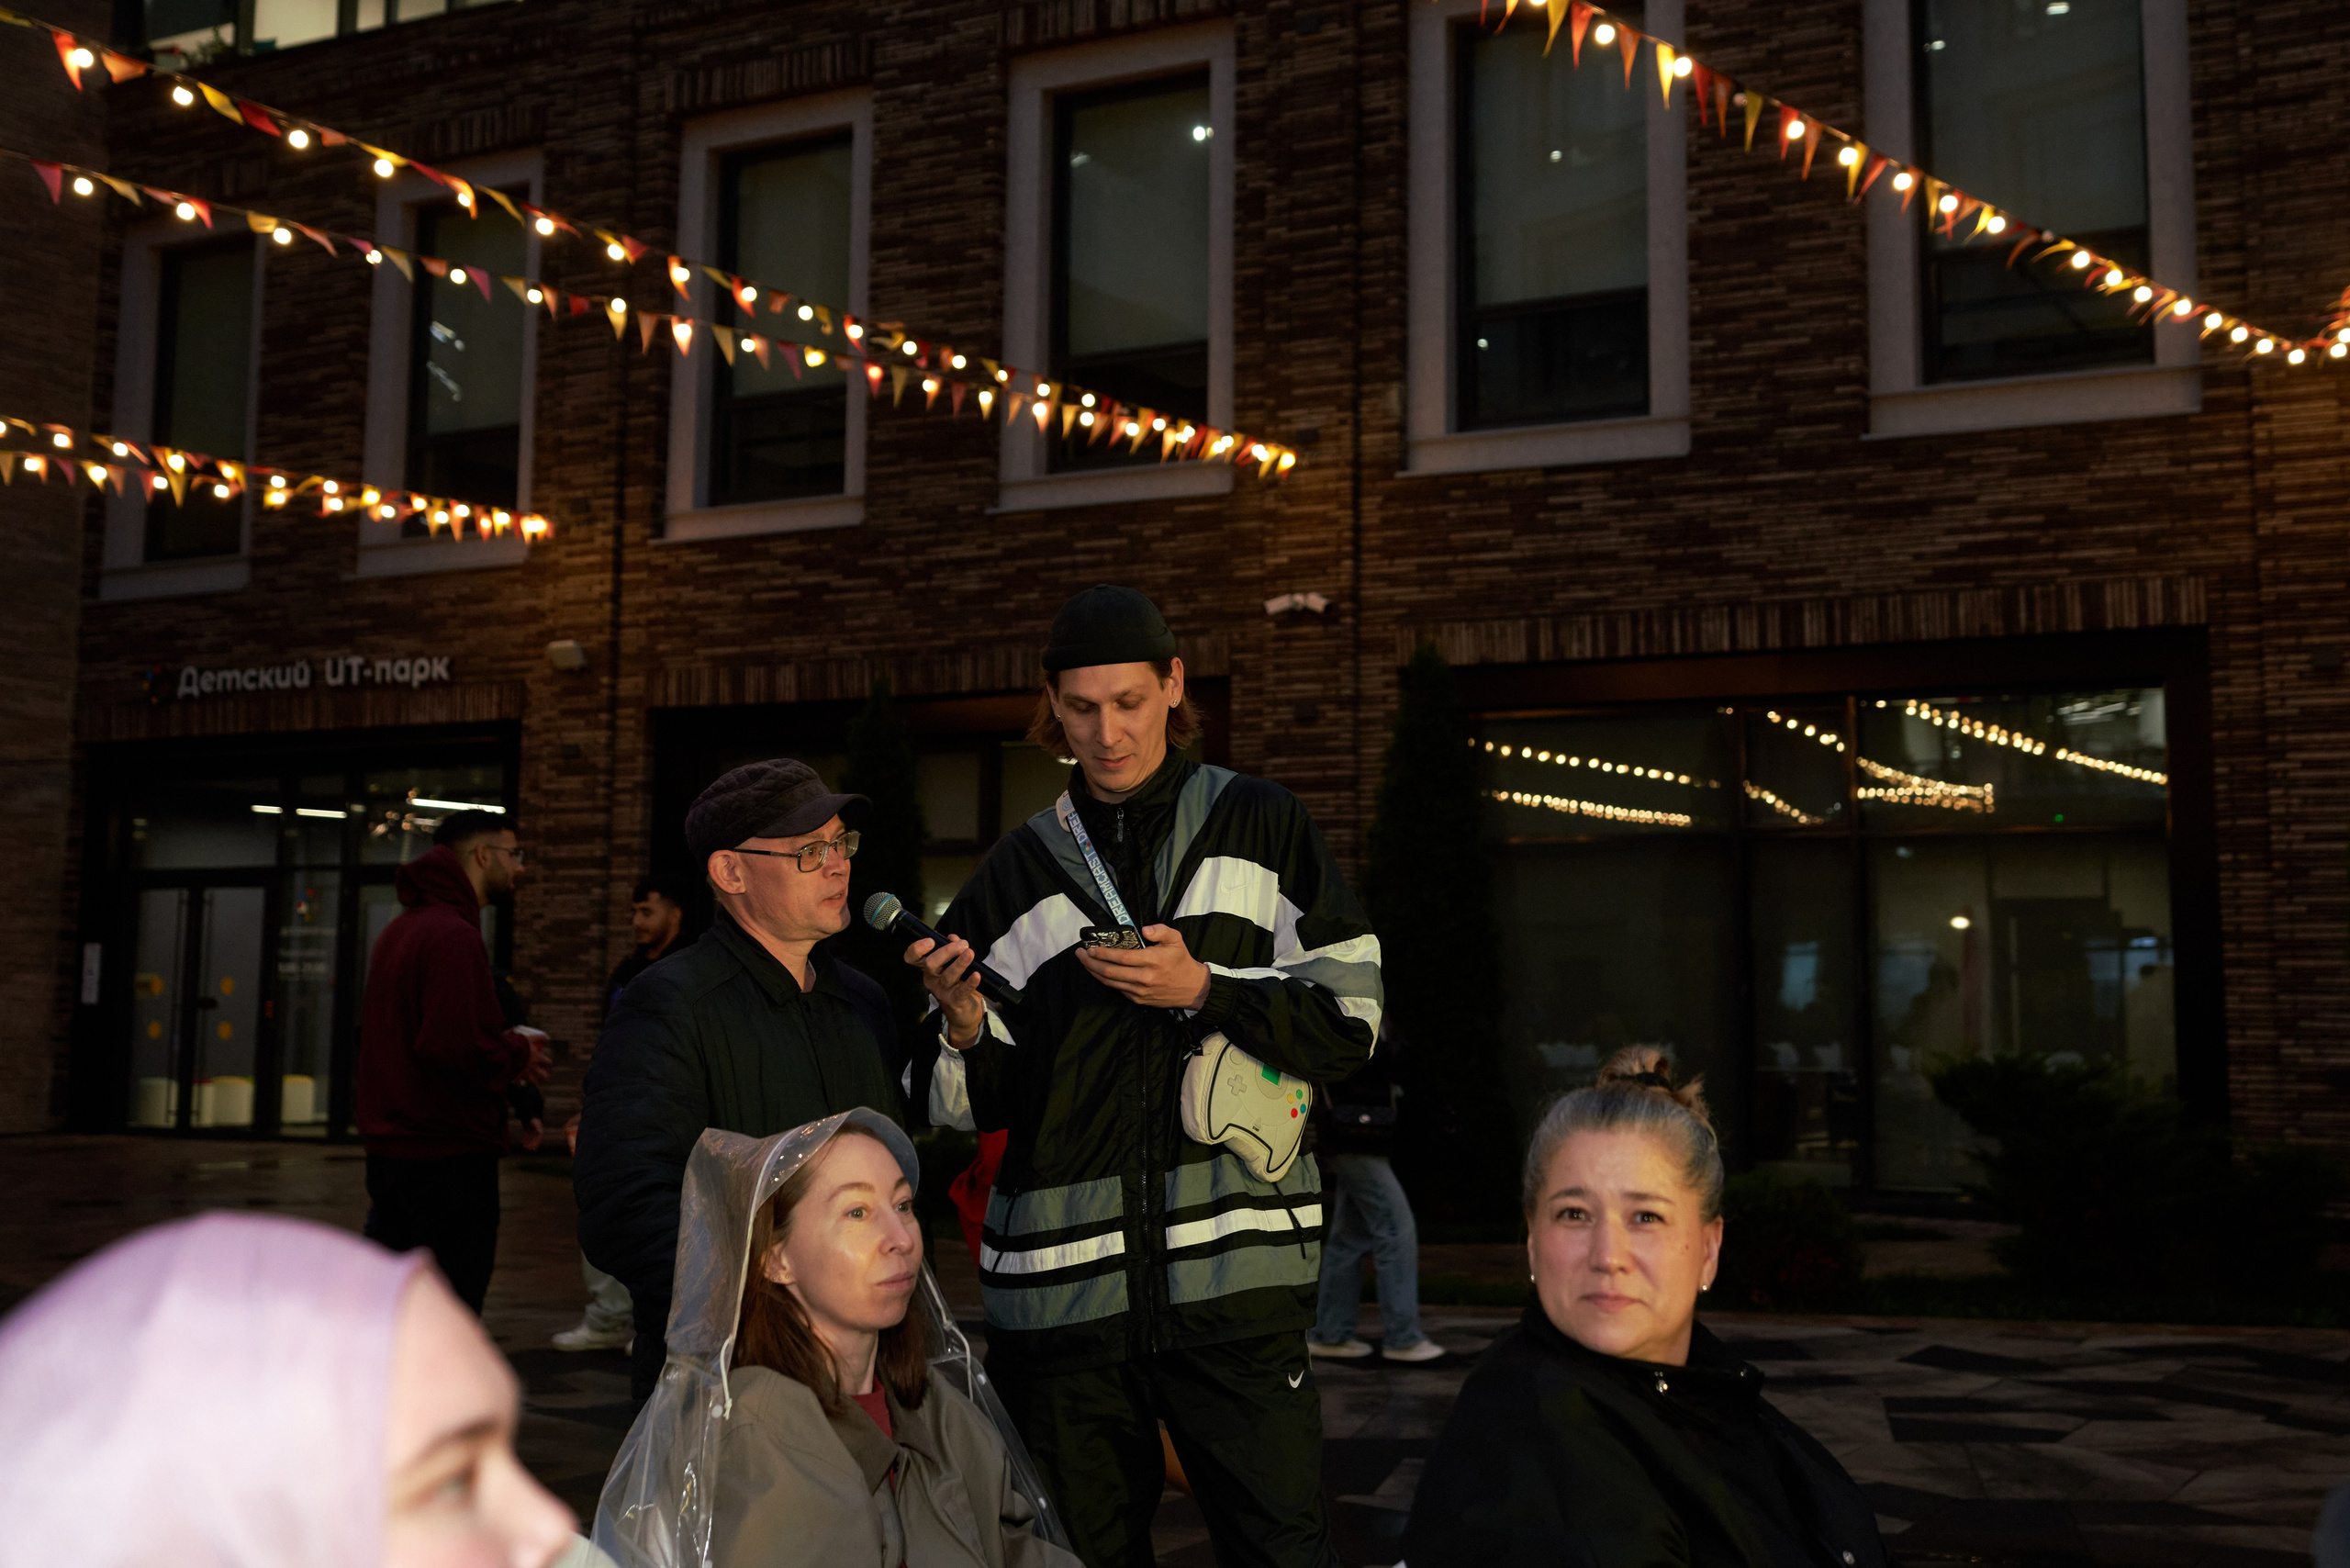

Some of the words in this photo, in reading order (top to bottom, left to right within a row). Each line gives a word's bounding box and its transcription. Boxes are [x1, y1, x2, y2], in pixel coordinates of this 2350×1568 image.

[177, 661, 310, 700] Детский
[325, 655, 450, 689] ИТ-парк
[1084, 851, 1130, 925] DREAMCAST
